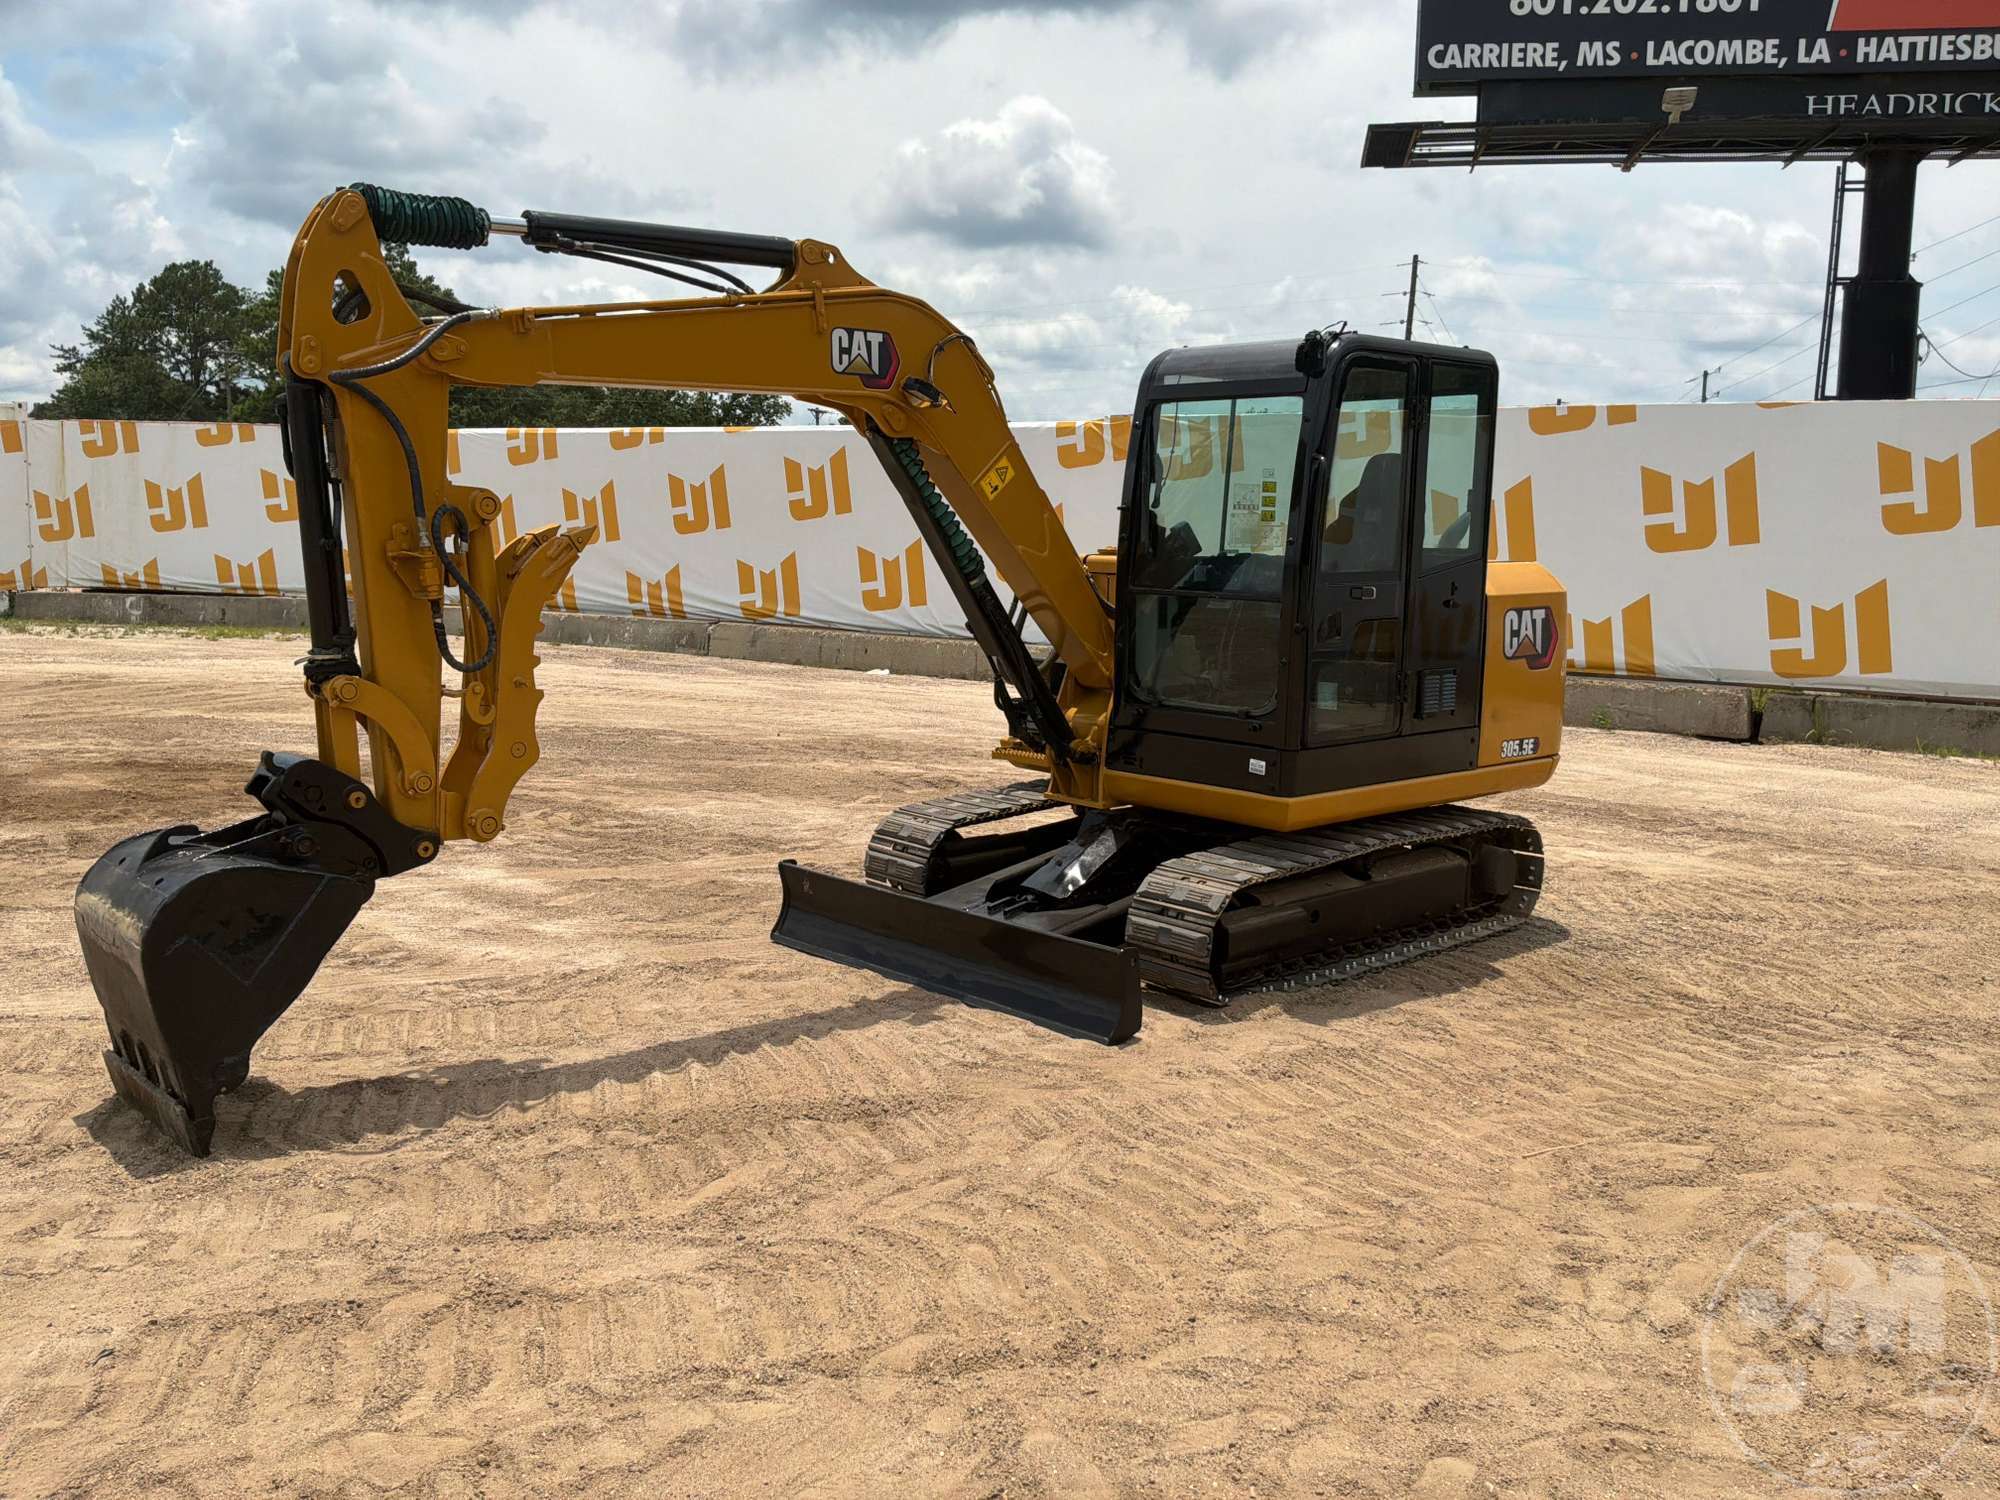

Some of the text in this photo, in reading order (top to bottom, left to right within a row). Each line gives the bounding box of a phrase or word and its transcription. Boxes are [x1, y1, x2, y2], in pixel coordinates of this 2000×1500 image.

[1427, 42, 1569, 71] CARRIERE,
[1576, 41, 1621, 67] MS
[1646, 38, 1788, 68] LACOMBE,
[1797, 38, 1831, 64] LA
[832, 328, 884, 376] CAT
[1504, 608, 1546, 658] CAT
[1501, 738, 1536, 758] 305.5E
